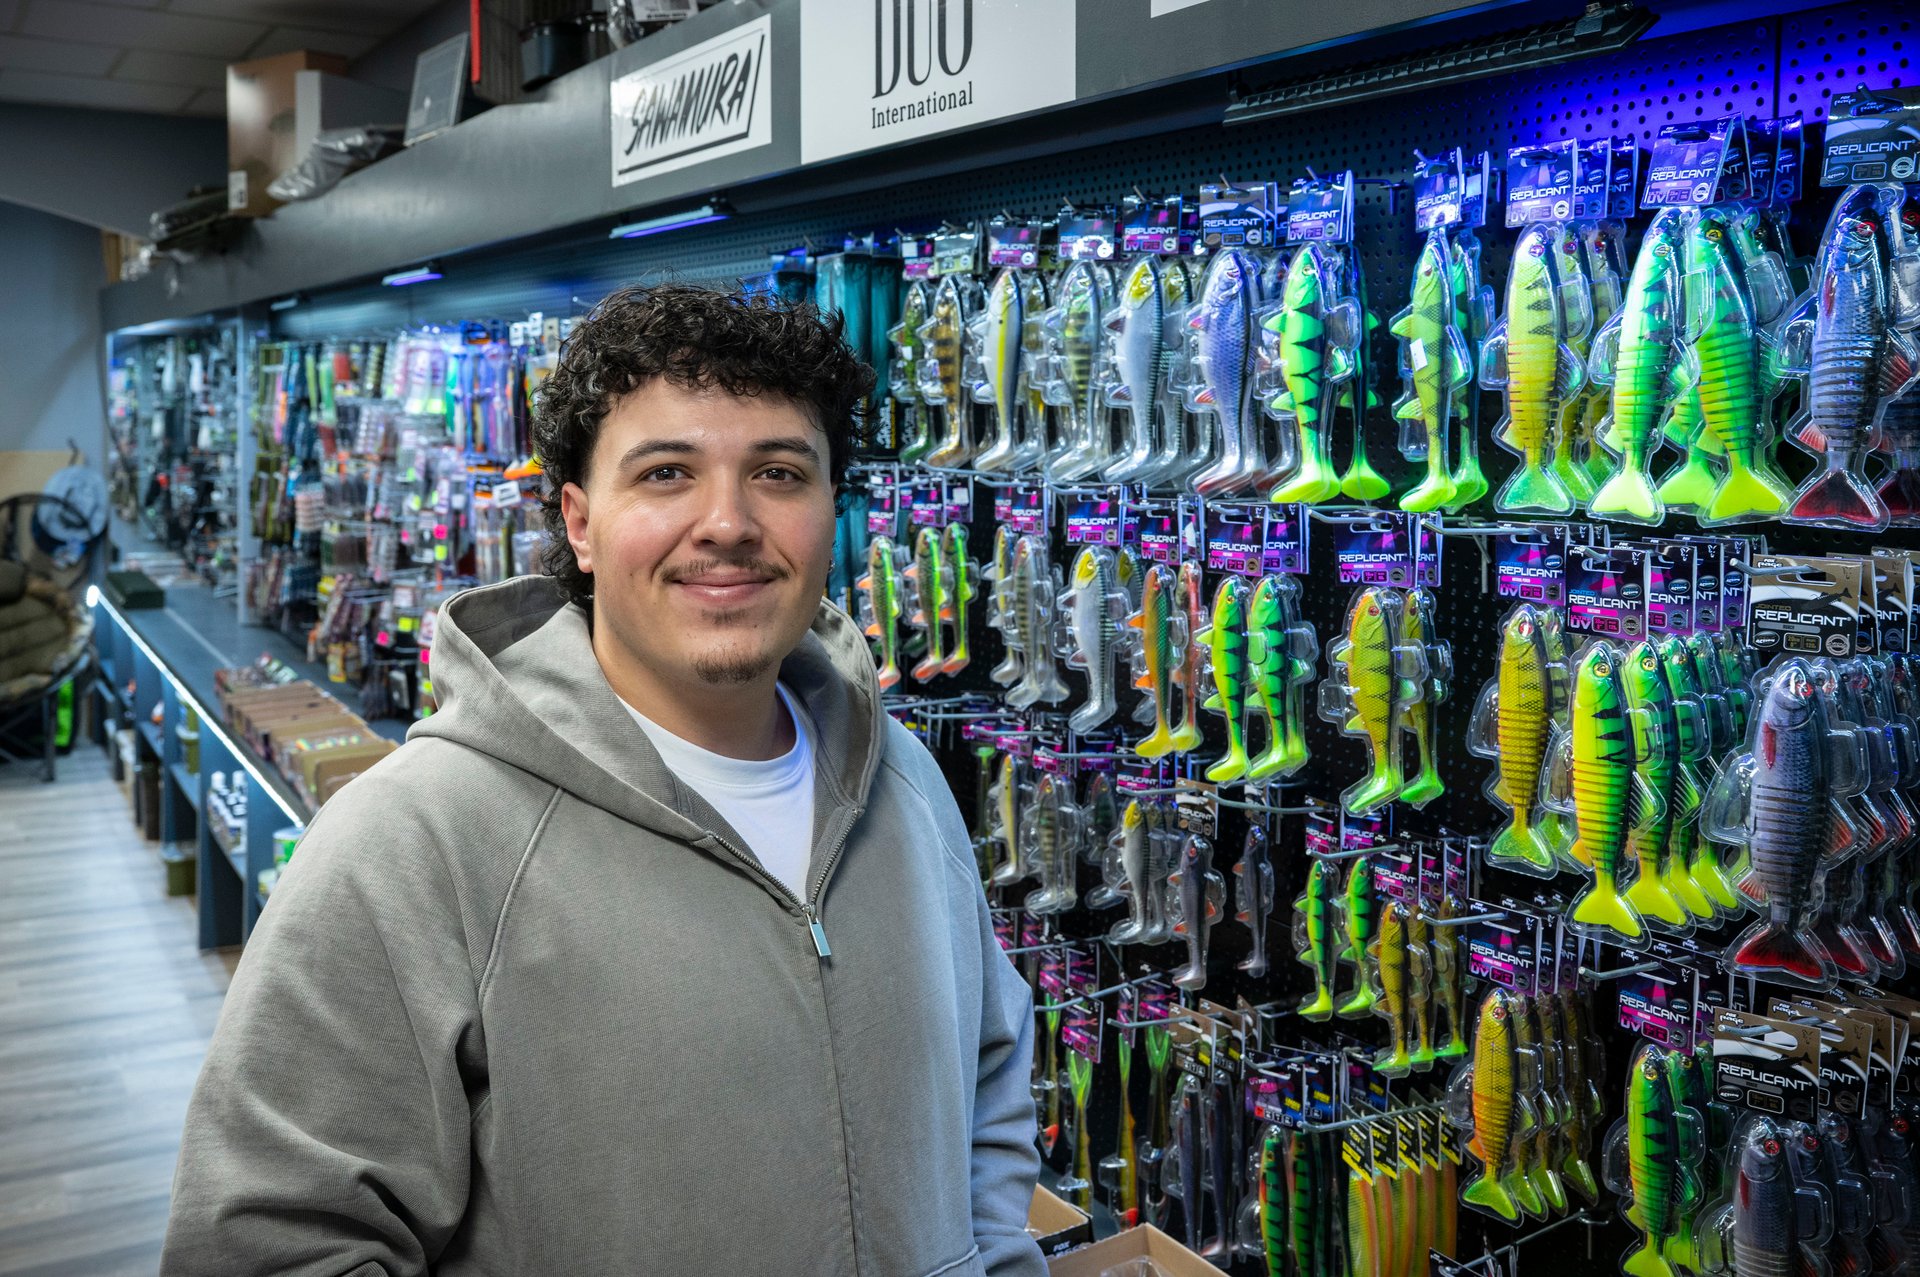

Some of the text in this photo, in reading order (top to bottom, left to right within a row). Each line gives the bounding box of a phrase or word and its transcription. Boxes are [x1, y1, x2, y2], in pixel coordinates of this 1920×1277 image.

[872, 0, 973, 99] DUO
[625, 49, 752, 156] SAWAMURA
[872, 81, 973, 129] International
[1828, 140, 1912, 156] REPLICANT
[1651, 168, 1714, 181] REPLICANT
[1417, 192, 1456, 208] REPLICANT
[1510, 186, 1569, 201] REPLICANT
[1203, 218, 1261, 228] REPLICANT
[1290, 210, 1339, 223] REPLICANT
[1124, 226, 1176, 235] REPLICANT
[1068, 517, 1117, 526] REPLICANT
[1142, 533, 1177, 543] REPLICANT
[1209, 541, 1259, 553] REPLICANT
[1339, 553, 1404, 562] REPLICANT
[1499, 565, 1560, 578] REPLICANT
[1569, 594, 1639, 610] REPLICANT
[1570, 618, 1591, 630] UV
[1755, 609, 1847, 627] REPLICANT
[1306, 827, 1338, 844] REPLICANT
[1374, 867, 1416, 883] REPLICANT
[1470, 943, 1531, 968] REPLICANT
[1620, 995, 1687, 1024] REPLICANT
[1719, 1062, 1808, 1091] REPLICANT
